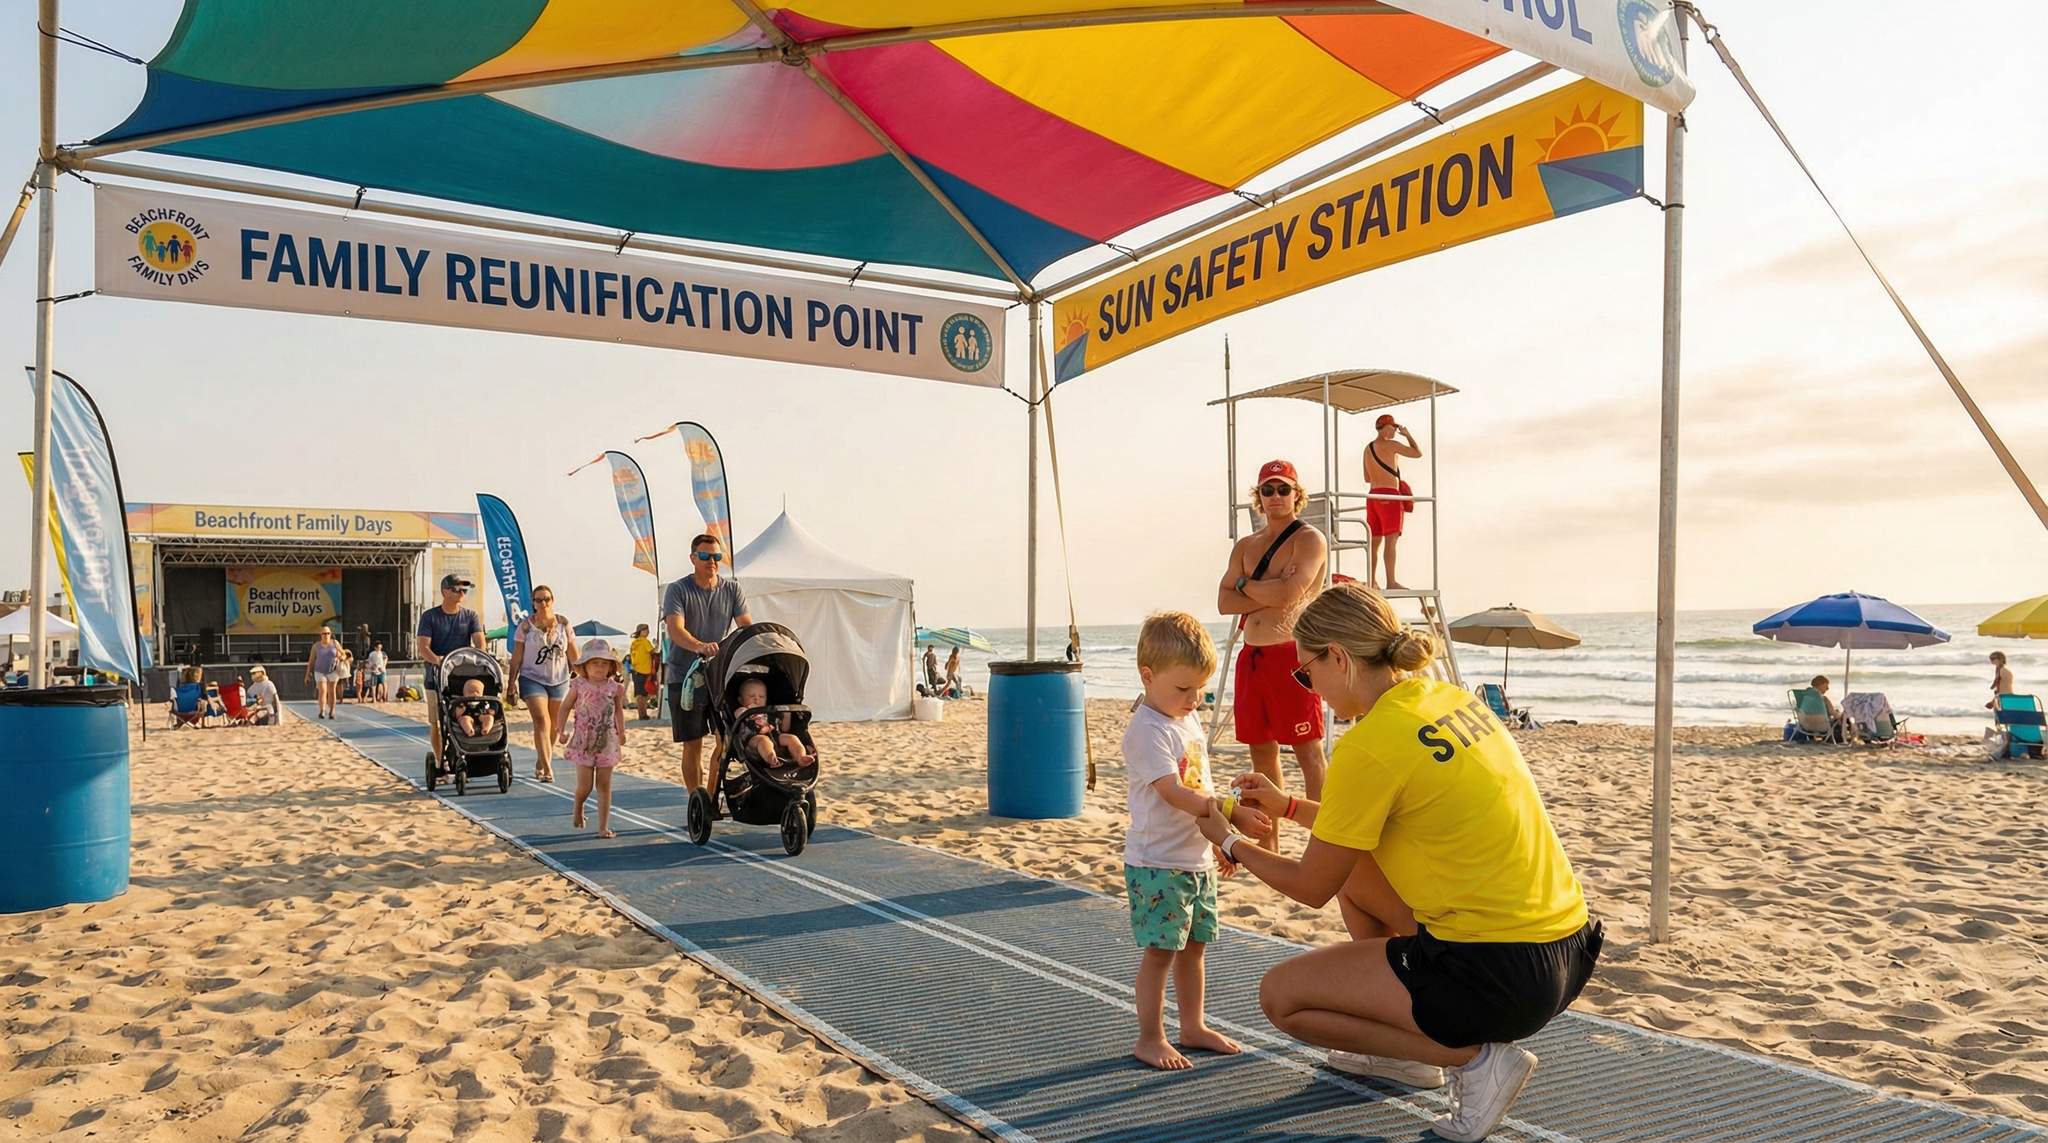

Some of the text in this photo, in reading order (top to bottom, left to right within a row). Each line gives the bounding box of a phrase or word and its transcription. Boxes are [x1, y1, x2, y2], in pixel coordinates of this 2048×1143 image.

[125, 208, 210, 241] BEACHFRONT
[1099, 134, 1514, 342] SUN SAFETY STATION
[127, 255, 210, 287] FAMILY DAYS
[240, 228, 431, 297] FAMILY
[445, 252, 793, 340] REUNIFICATION
[807, 299, 924, 356] POINT
[195, 510, 393, 536] Beachfront Family Days
[248, 601, 323, 617] Family Days
[249, 587, 320, 601] Beachfront
